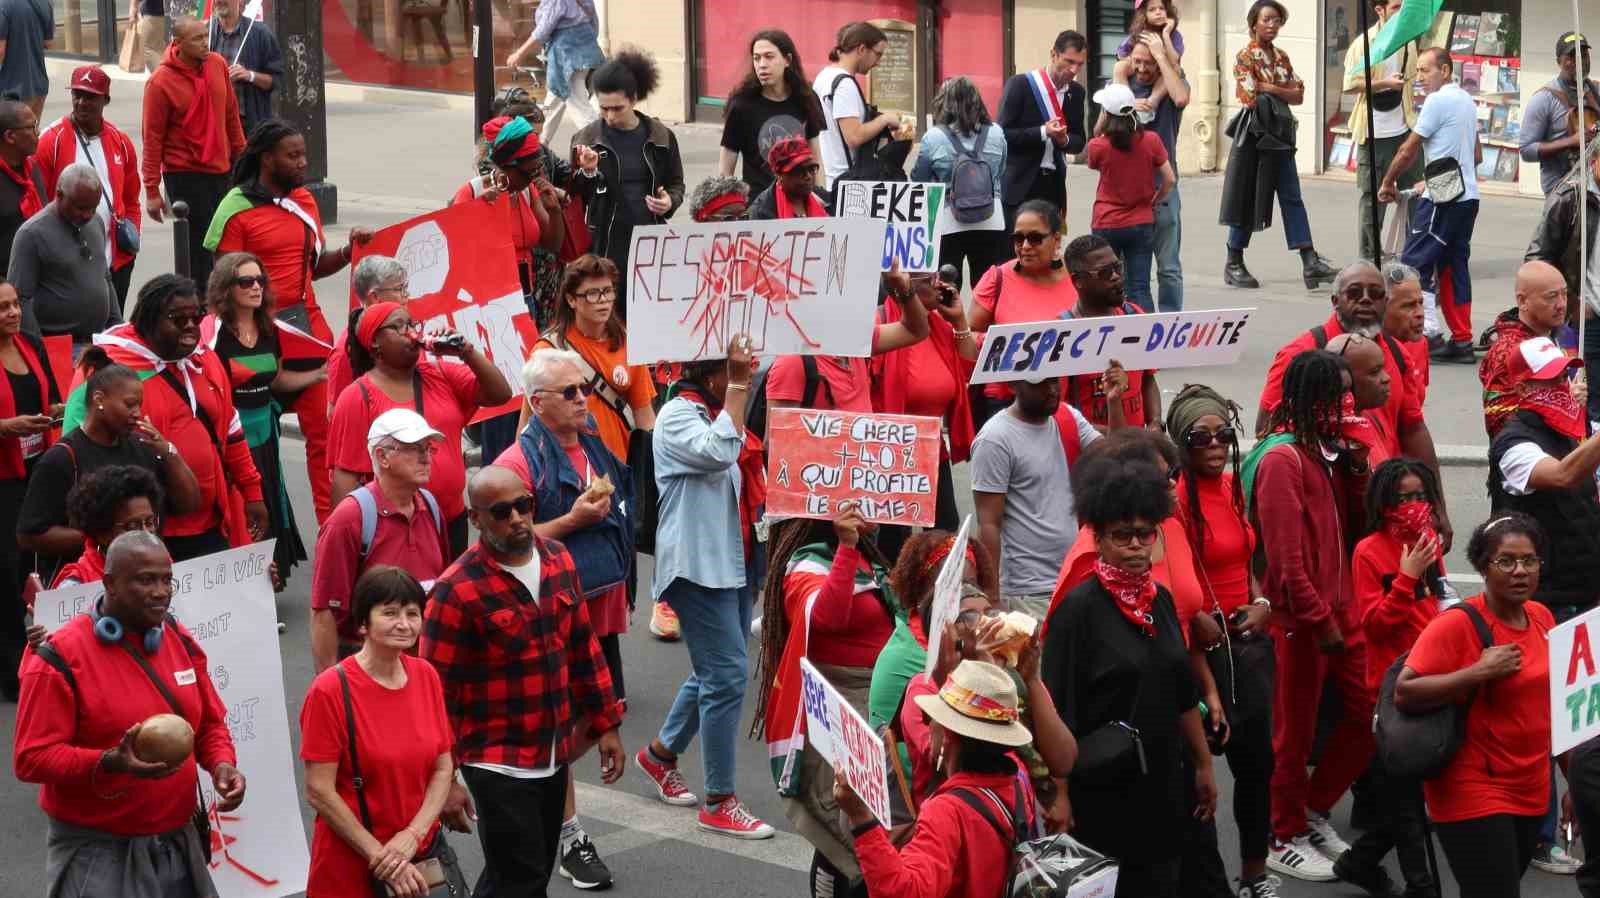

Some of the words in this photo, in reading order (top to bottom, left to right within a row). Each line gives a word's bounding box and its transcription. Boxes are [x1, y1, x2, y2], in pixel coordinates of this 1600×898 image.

[982, 325, 1116, 372] RESPECT
[801, 414, 842, 437] VIE
[777, 459, 790, 488] À
[807, 494, 829, 514] LE
